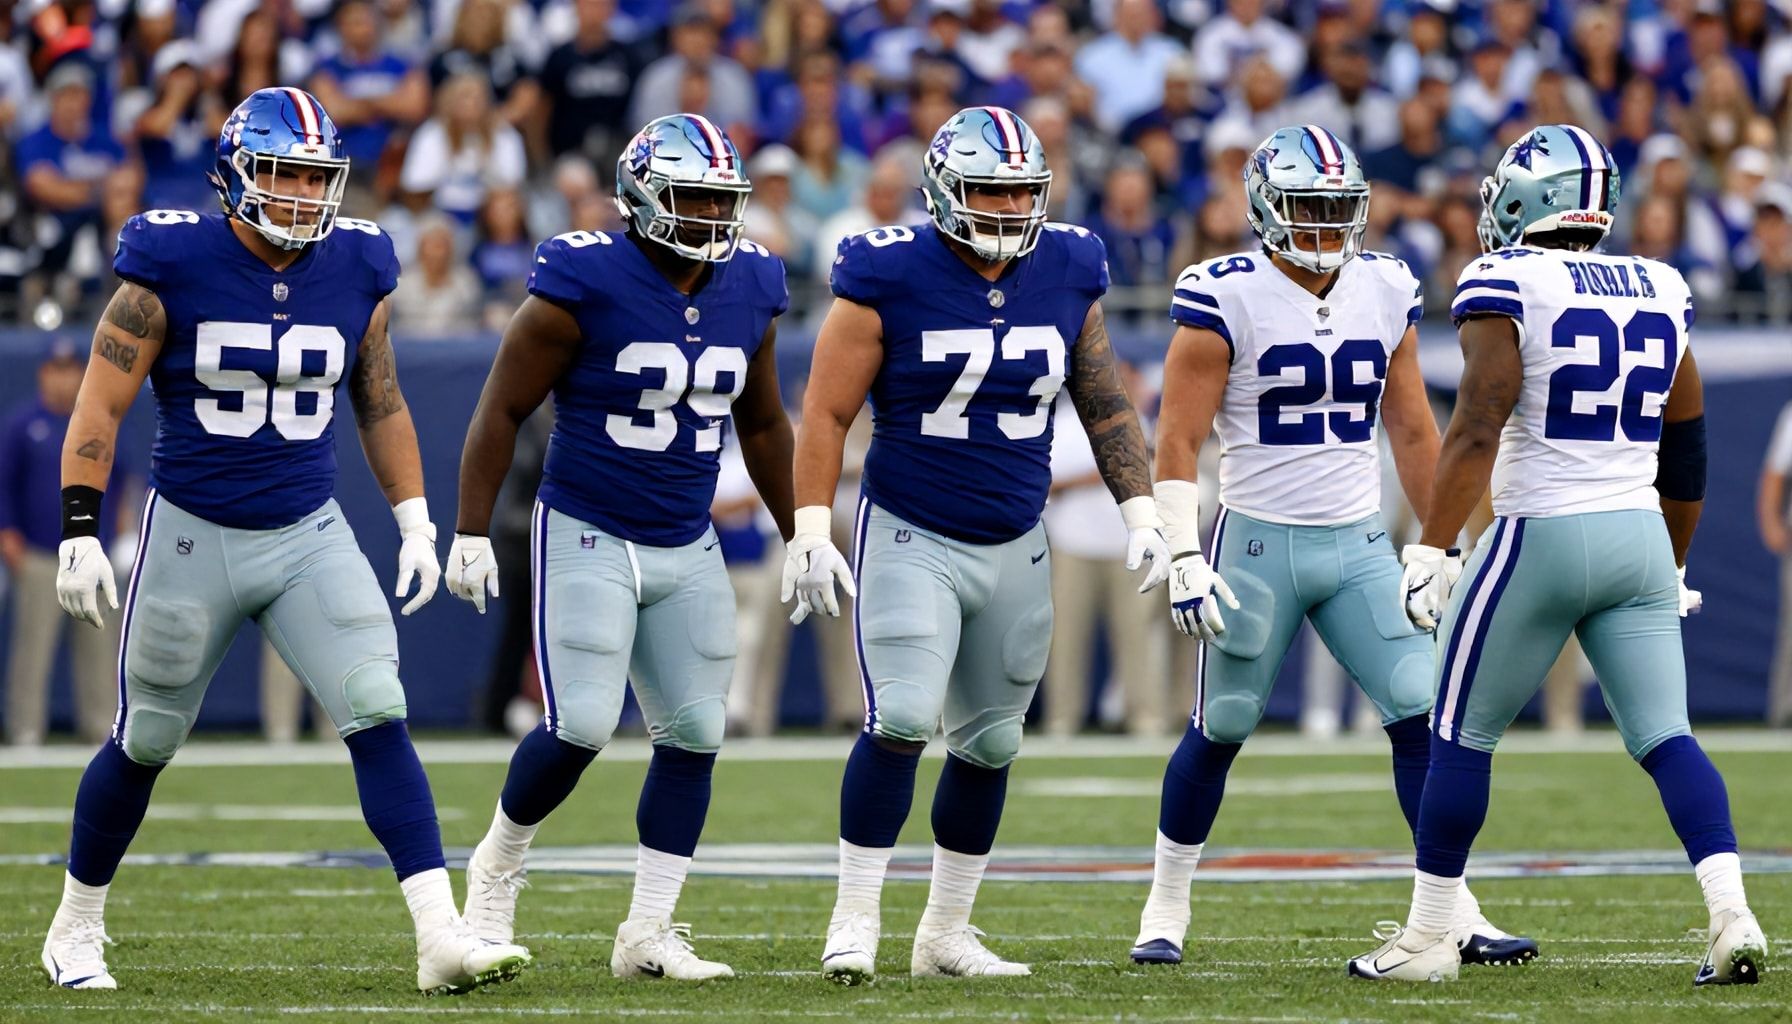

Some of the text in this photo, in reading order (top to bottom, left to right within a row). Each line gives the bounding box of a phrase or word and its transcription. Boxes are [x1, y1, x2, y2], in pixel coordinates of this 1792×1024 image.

[194, 320, 346, 441] 58
[605, 341, 748, 453] 39
[920, 325, 1067, 441] 73
[1544, 307, 1678, 443] 22
